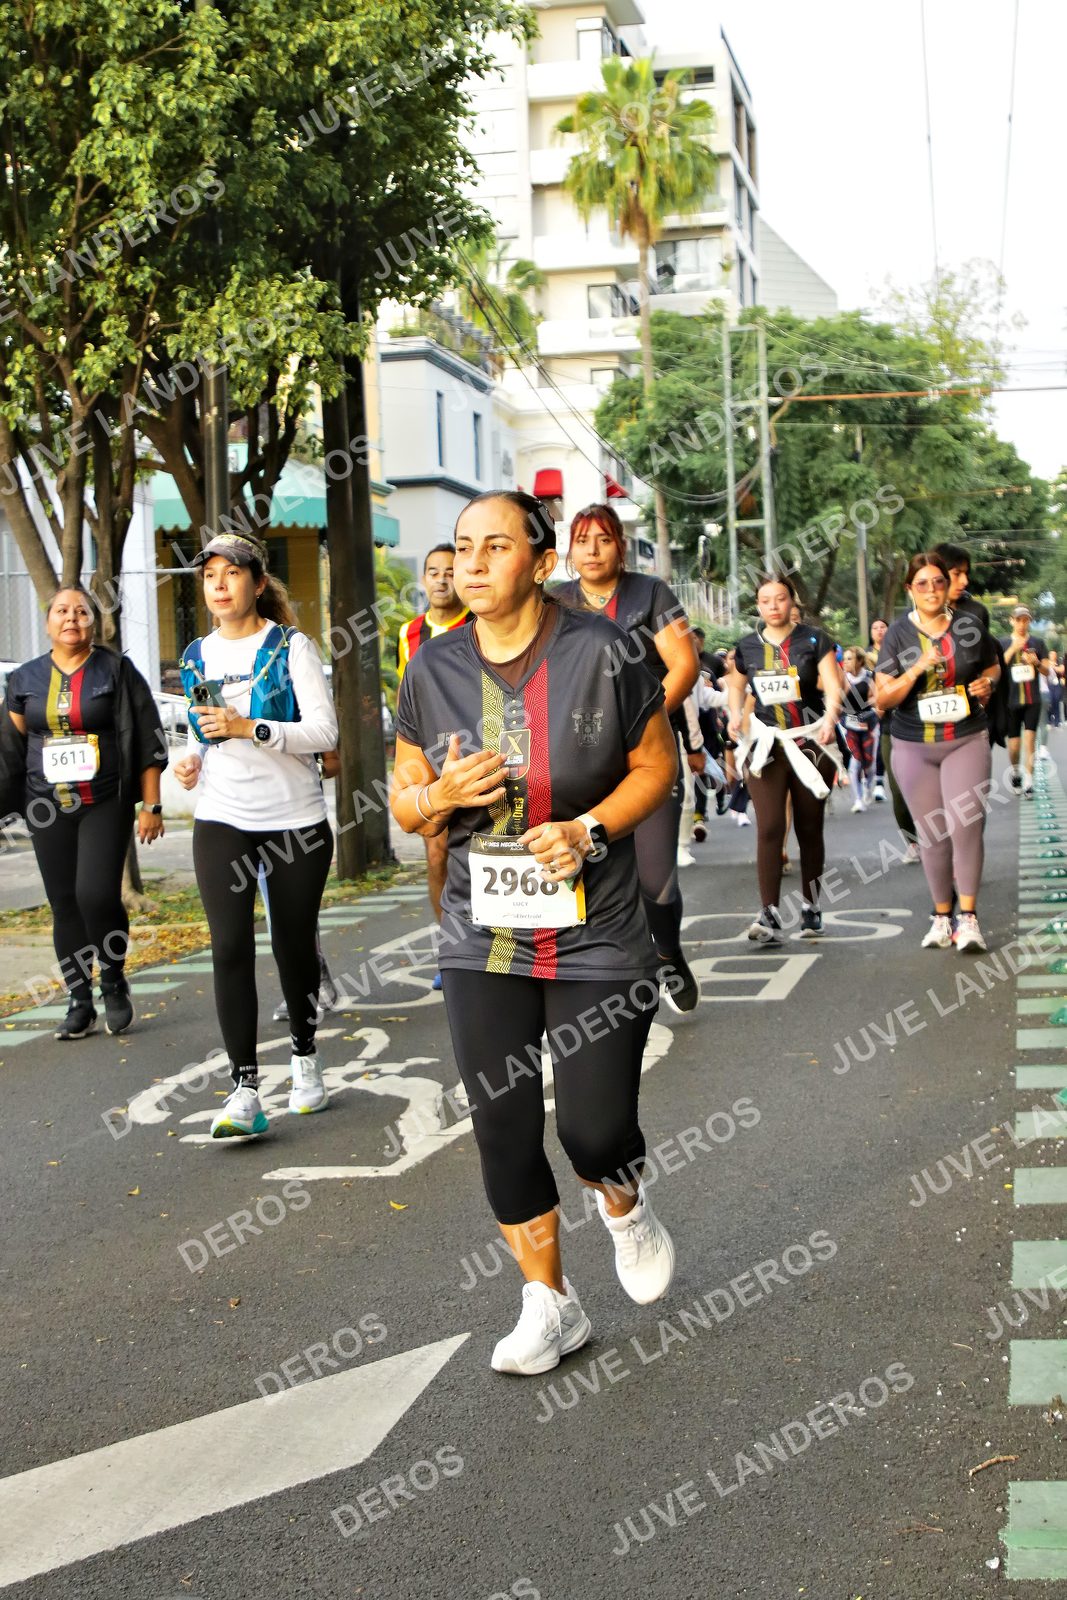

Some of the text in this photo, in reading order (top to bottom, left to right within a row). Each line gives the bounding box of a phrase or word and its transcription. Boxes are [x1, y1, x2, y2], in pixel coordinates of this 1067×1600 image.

[761, 680, 790, 693] 5474
[927, 699, 958, 716] 1372
[51, 749, 86, 766] 5611
